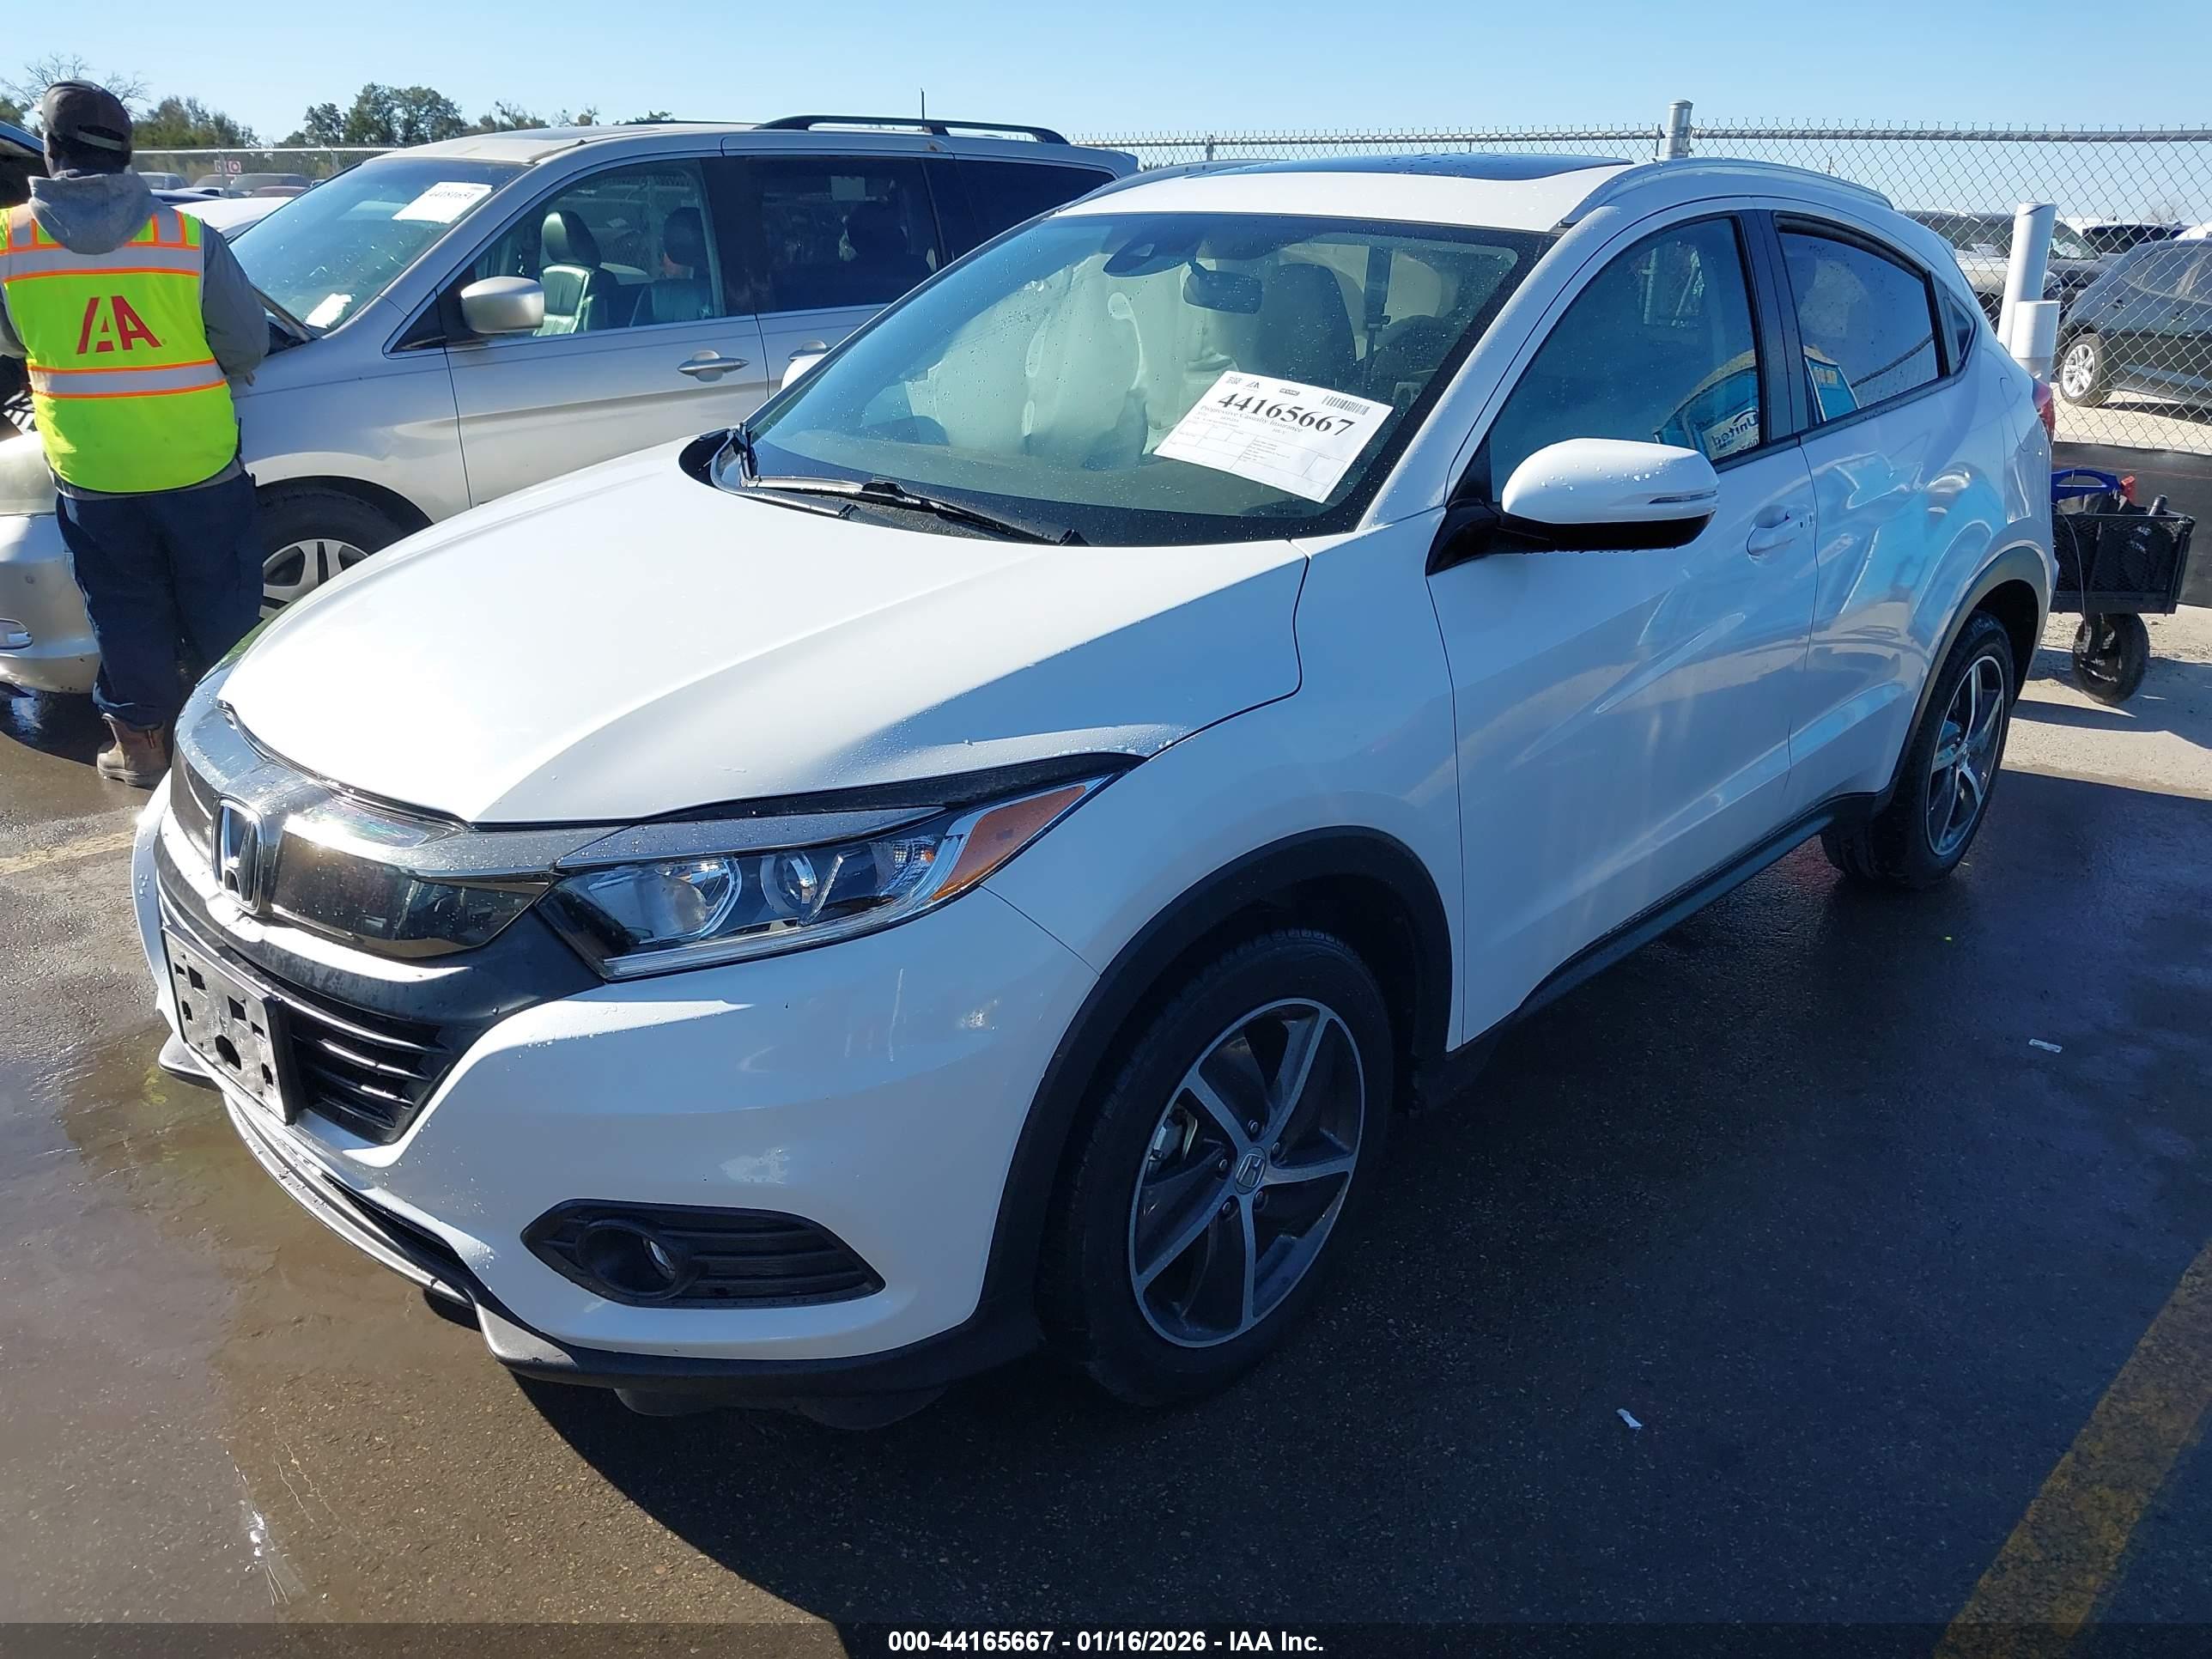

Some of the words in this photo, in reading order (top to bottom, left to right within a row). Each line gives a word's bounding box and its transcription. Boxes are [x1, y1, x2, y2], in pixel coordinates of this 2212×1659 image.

[1218, 392, 1355, 435] 44165667
[1239, 413, 1269, 424] Casualty
[1269, 419, 1304, 433] Insurance
